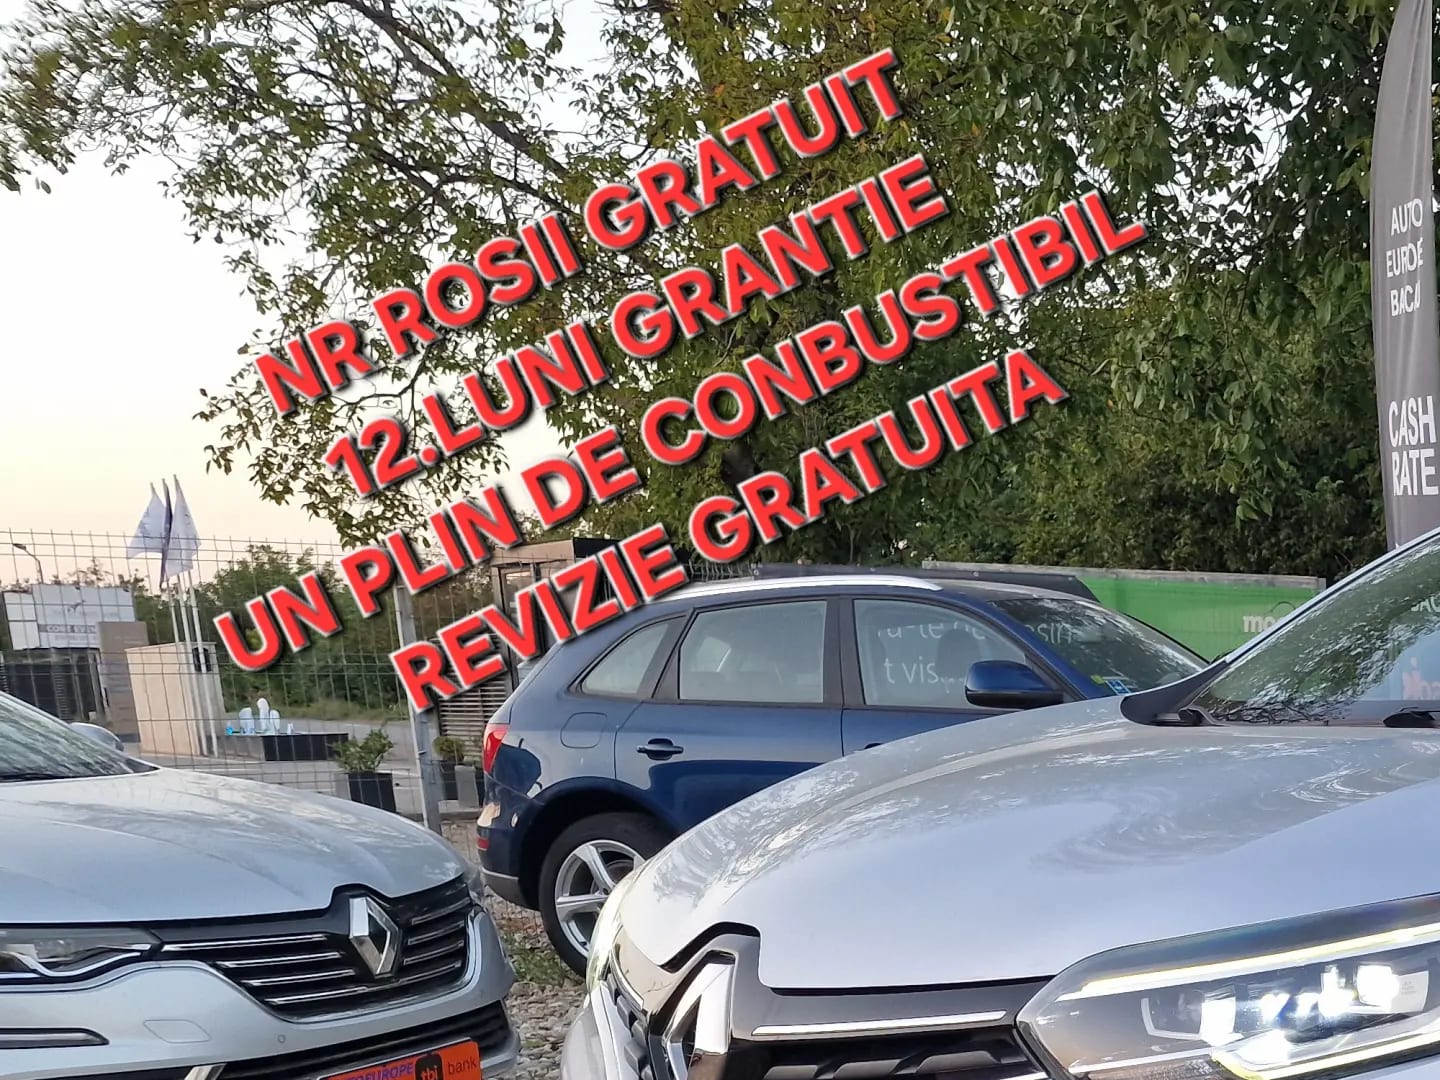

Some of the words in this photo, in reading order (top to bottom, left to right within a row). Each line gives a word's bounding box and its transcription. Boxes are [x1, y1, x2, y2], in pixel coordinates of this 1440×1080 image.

[1390, 197, 1424, 237] AUTO
[1388, 395, 1438, 449] CASH
[1391, 447, 1439, 496] RATE
[447, 1057, 478, 1075] bank
